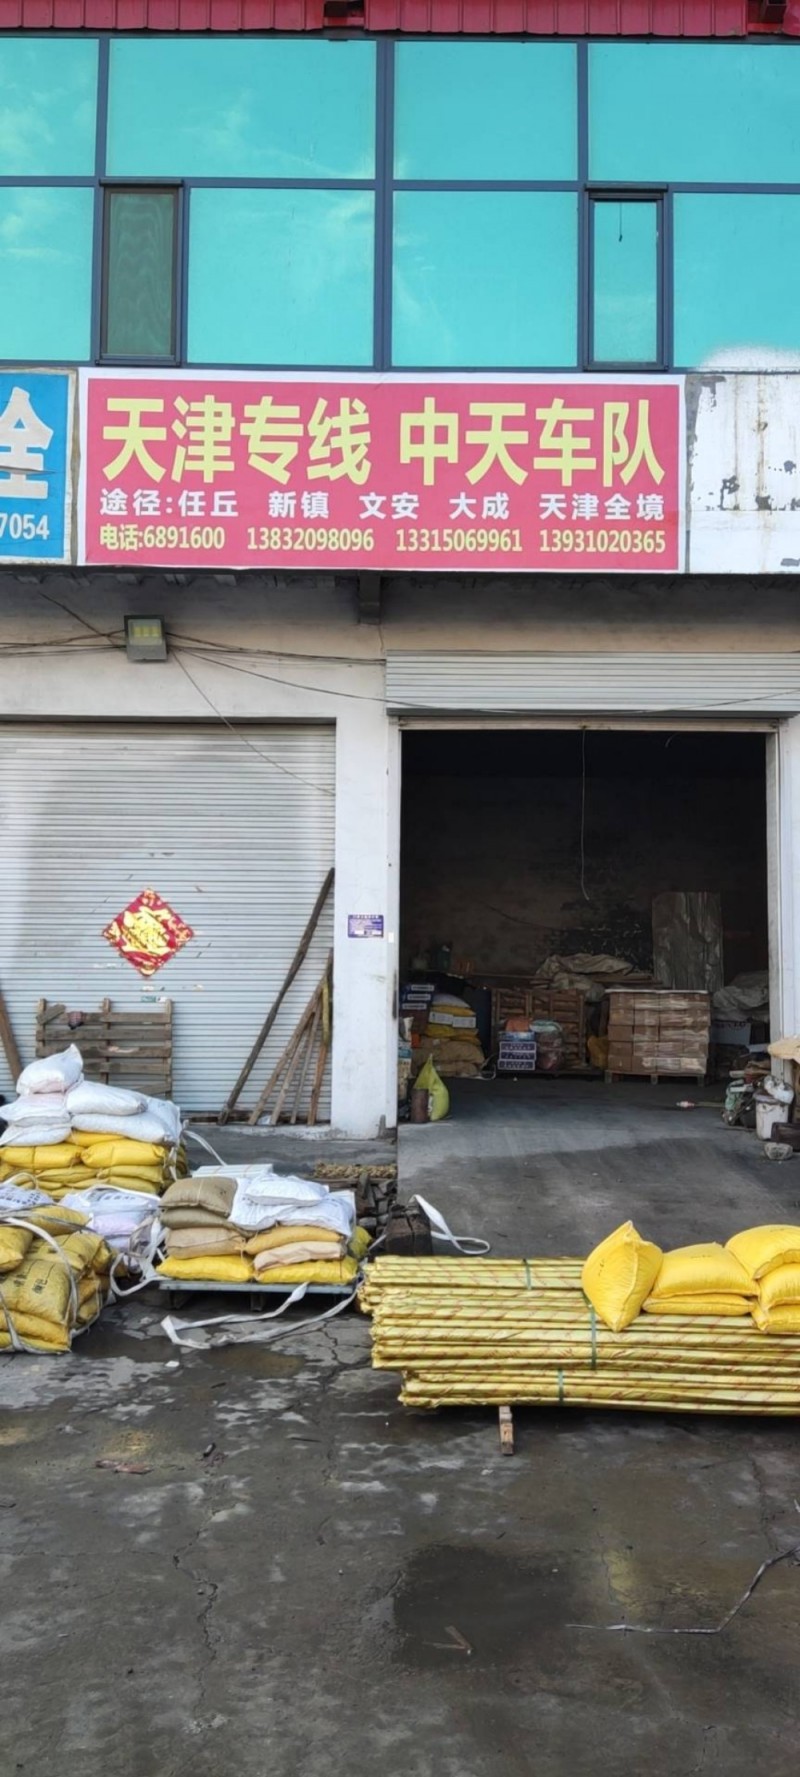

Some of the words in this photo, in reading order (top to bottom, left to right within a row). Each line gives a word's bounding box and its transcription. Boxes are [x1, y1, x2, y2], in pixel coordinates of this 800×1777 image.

[102, 395, 372, 486] 天津专线
[399, 396, 666, 488] 中天车队
[99, 488, 239, 518] 途径:任丘
[268, 490, 330, 519] 新镇
[358, 491, 420, 520] 文安
[449, 491, 510, 520] 大成
[538, 492, 666, 521] 天津全境
[99, 523, 226, 551] 电话:6891600
[247, 526, 375, 551] 13832098096
[396, 528, 523, 552] 13315069961
[539, 529, 666, 554] 13931020365
